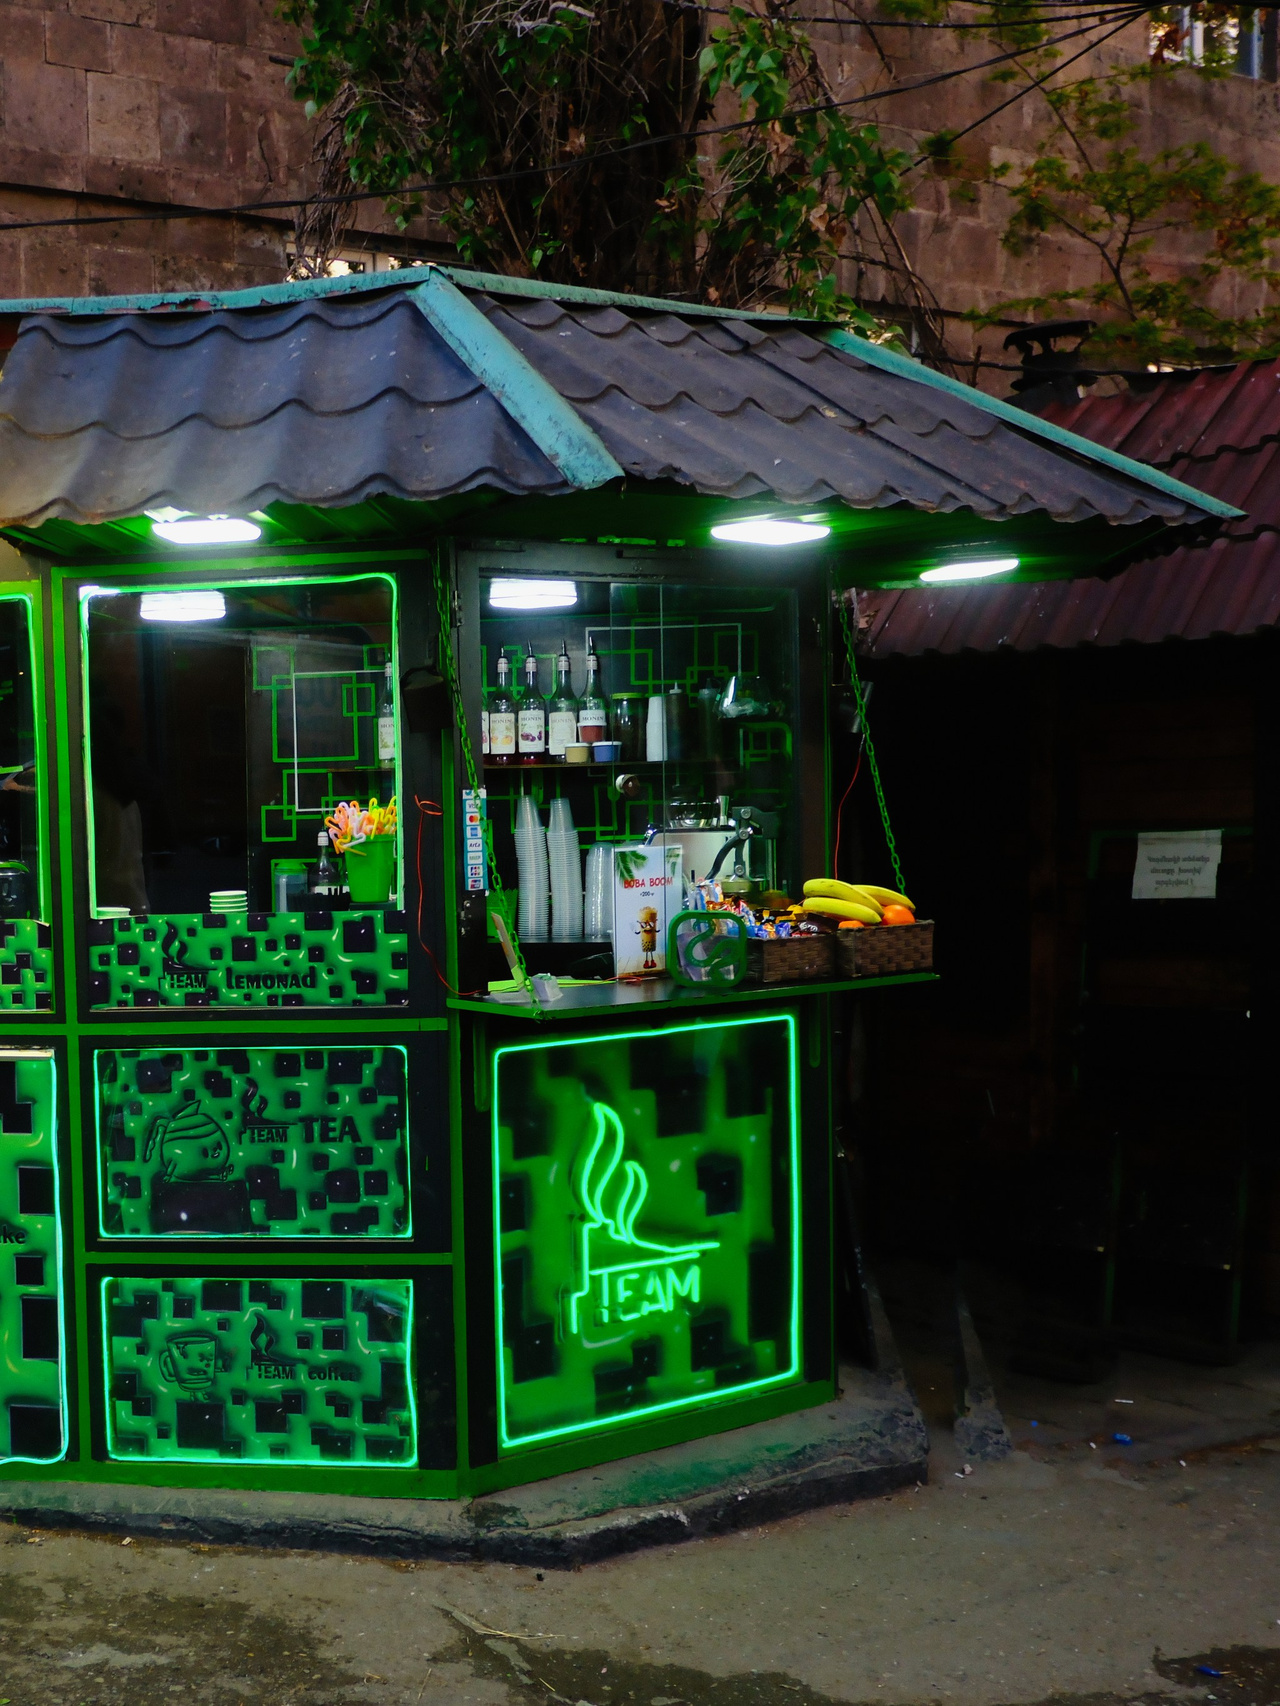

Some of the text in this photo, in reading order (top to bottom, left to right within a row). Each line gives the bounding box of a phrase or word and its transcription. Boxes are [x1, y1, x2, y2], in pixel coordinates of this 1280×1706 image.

[623, 877, 673, 889] BOBA BOOM
[169, 973, 207, 989] TEAM
[249, 1116, 362, 1143] TEAM TEA
[600, 1263, 701, 1324] TEAM
[256, 1364, 295, 1380] TEAM
